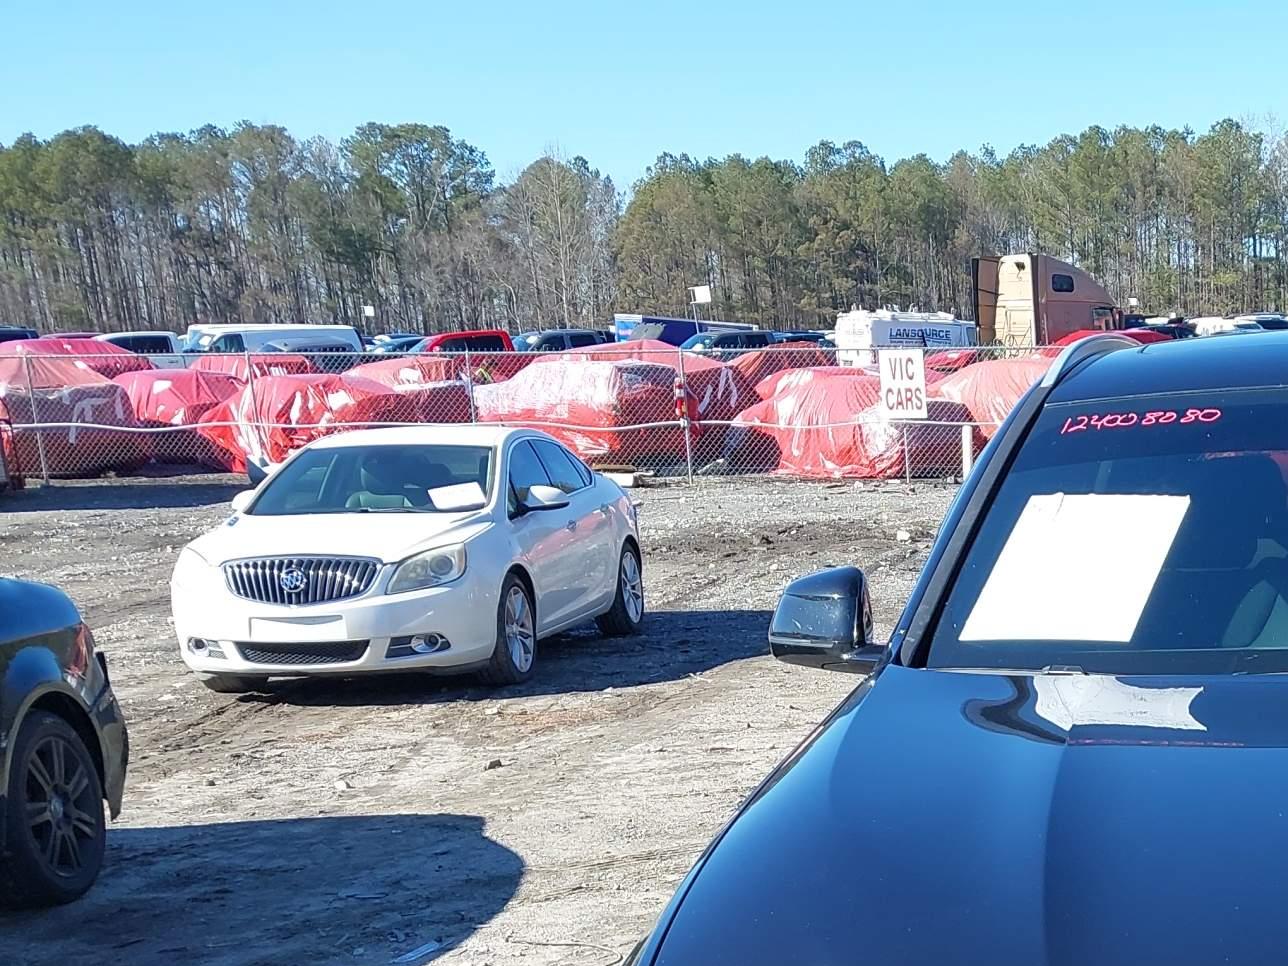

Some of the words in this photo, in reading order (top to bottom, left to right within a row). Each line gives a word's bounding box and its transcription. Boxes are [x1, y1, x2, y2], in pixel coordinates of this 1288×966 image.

[889, 327, 951, 339] LANSOURCE
[888, 357, 915, 380] VIC
[885, 387, 923, 410] CARS
